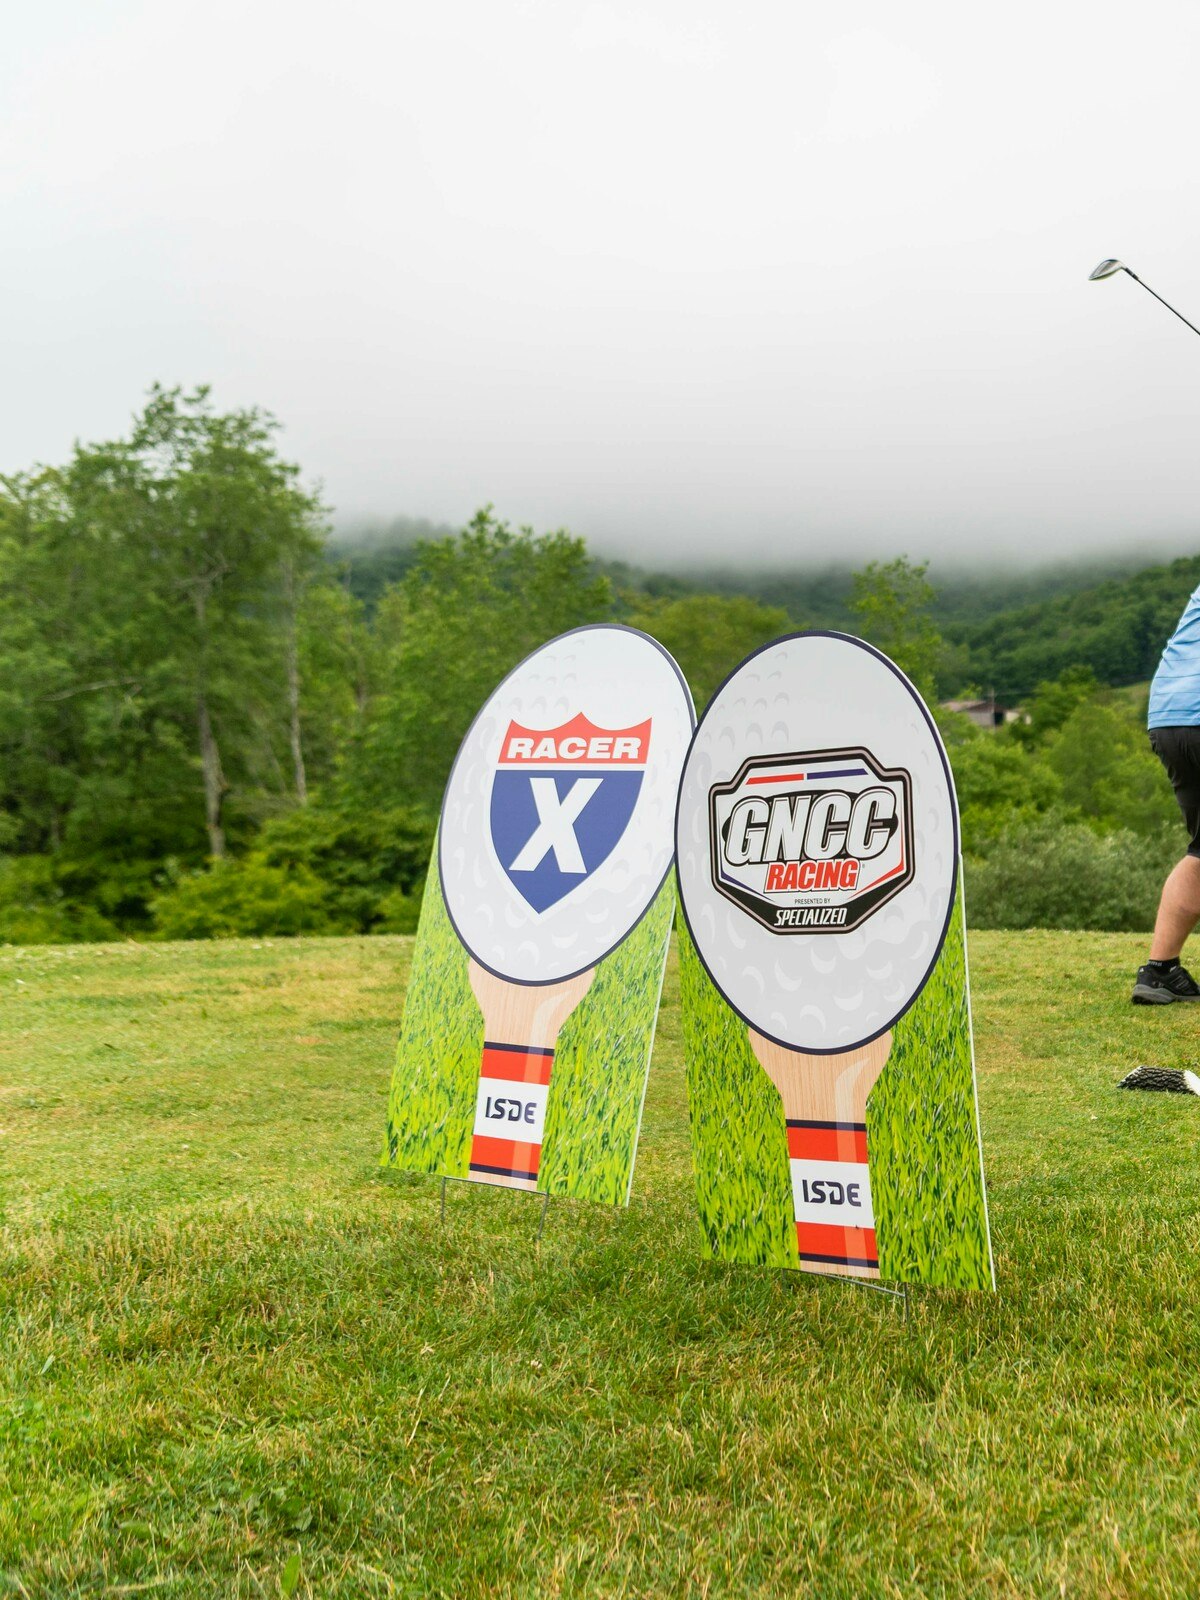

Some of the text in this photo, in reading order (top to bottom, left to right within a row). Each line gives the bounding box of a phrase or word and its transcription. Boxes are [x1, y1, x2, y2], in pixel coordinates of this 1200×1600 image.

[506, 736, 642, 760] RACER
[508, 777, 604, 874] X
[725, 787, 896, 865] GNCC
[765, 860, 859, 892] RACING
[774, 907, 848, 926] SPECIALIZED
[485, 1096, 537, 1125] ISDE
[802, 1179, 862, 1208] ISDE
